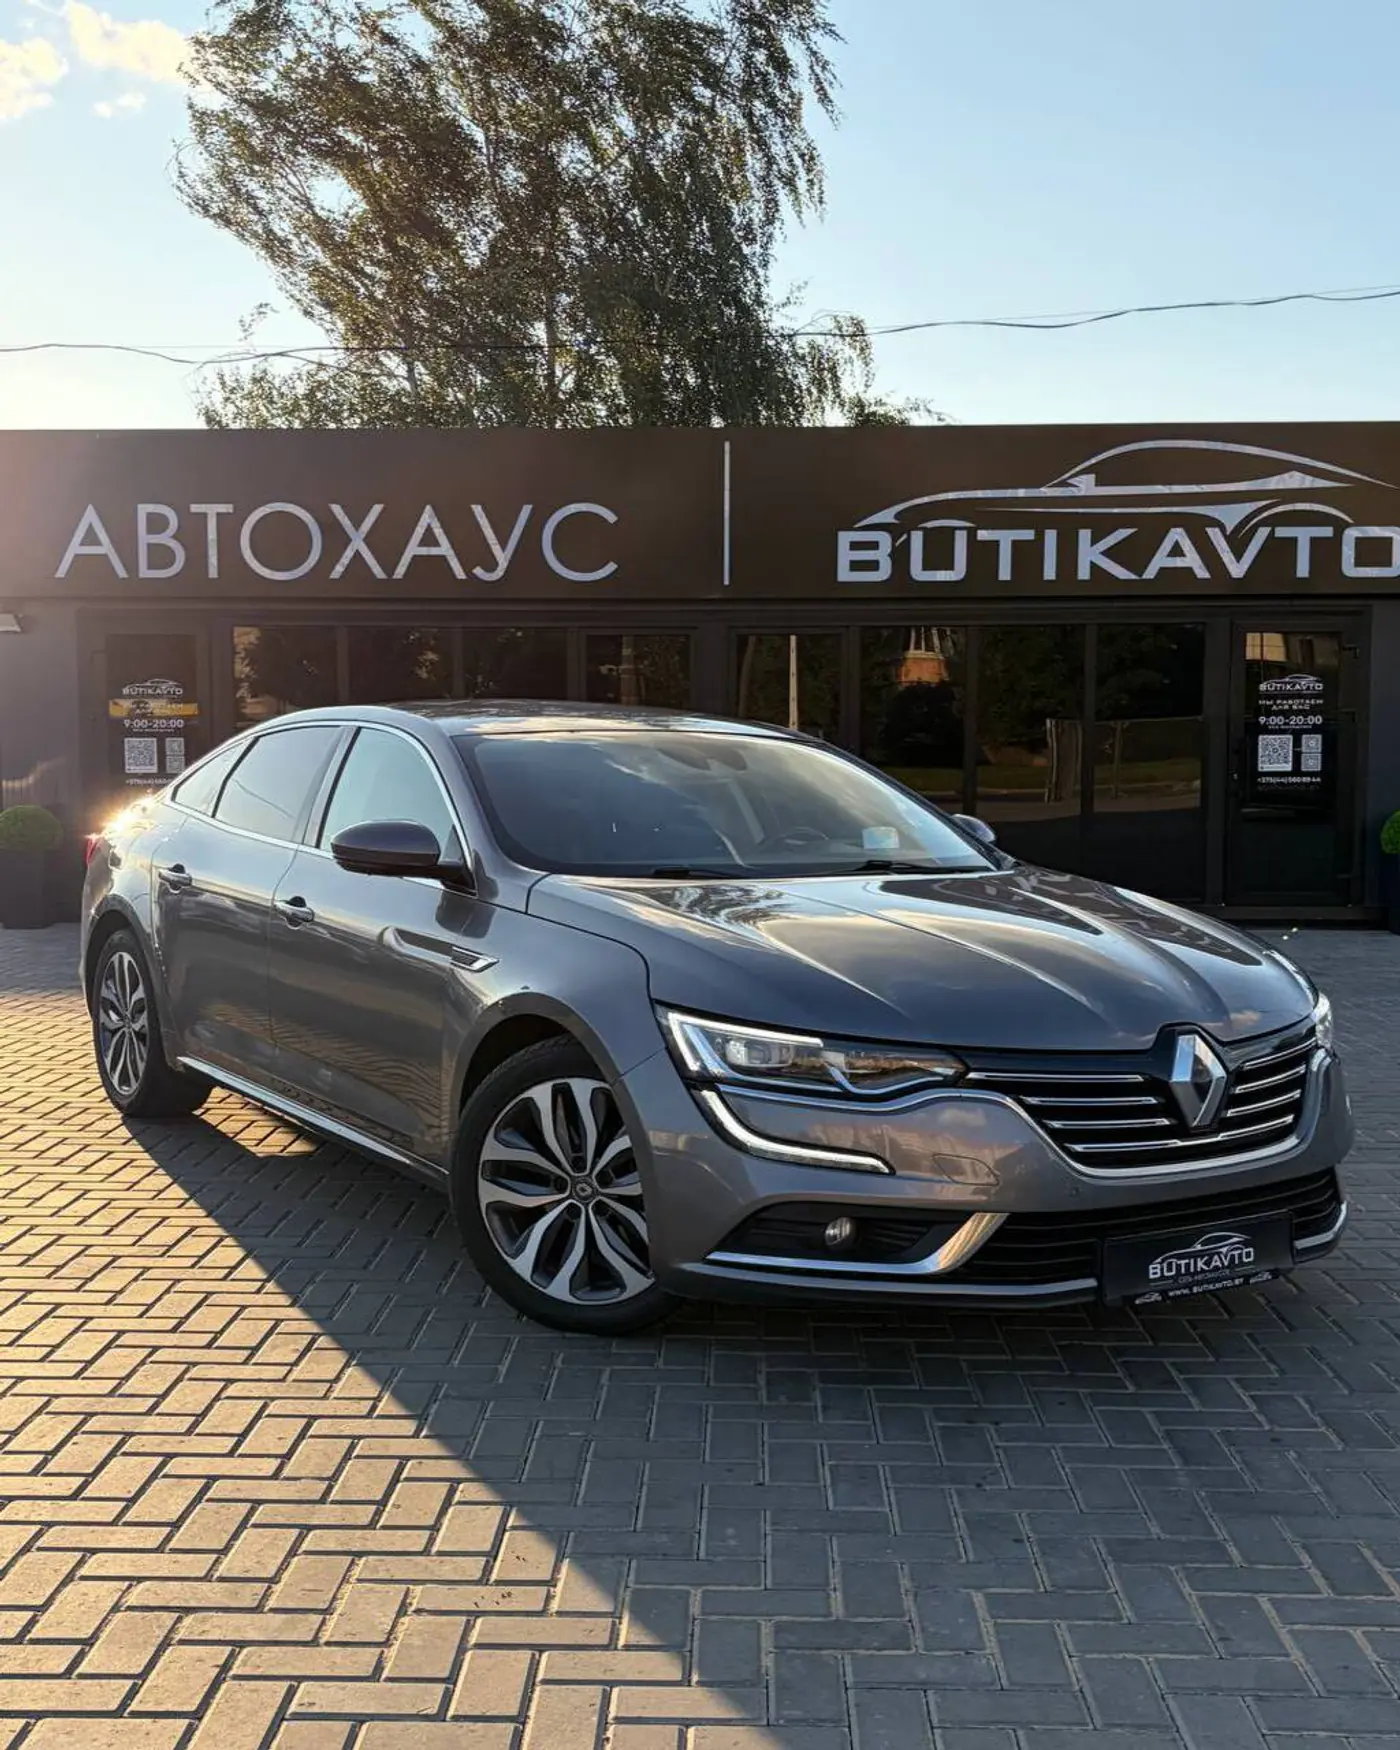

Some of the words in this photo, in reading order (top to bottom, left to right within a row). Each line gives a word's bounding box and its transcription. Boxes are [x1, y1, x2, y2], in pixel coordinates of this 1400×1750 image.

[54, 502, 619, 582] АВТОХАУС
[836, 526, 1400, 583] BUTIKAVTO
[122, 686, 184, 696] BUTIKAVTO
[1258, 683, 1324, 692] BUTIKAVTO
[124, 719, 185, 728] 9:00-20:00
[1258, 715, 1323, 725] 9:00-20:00
[1149, 1247, 1254, 1279] BUTIKAVTO
